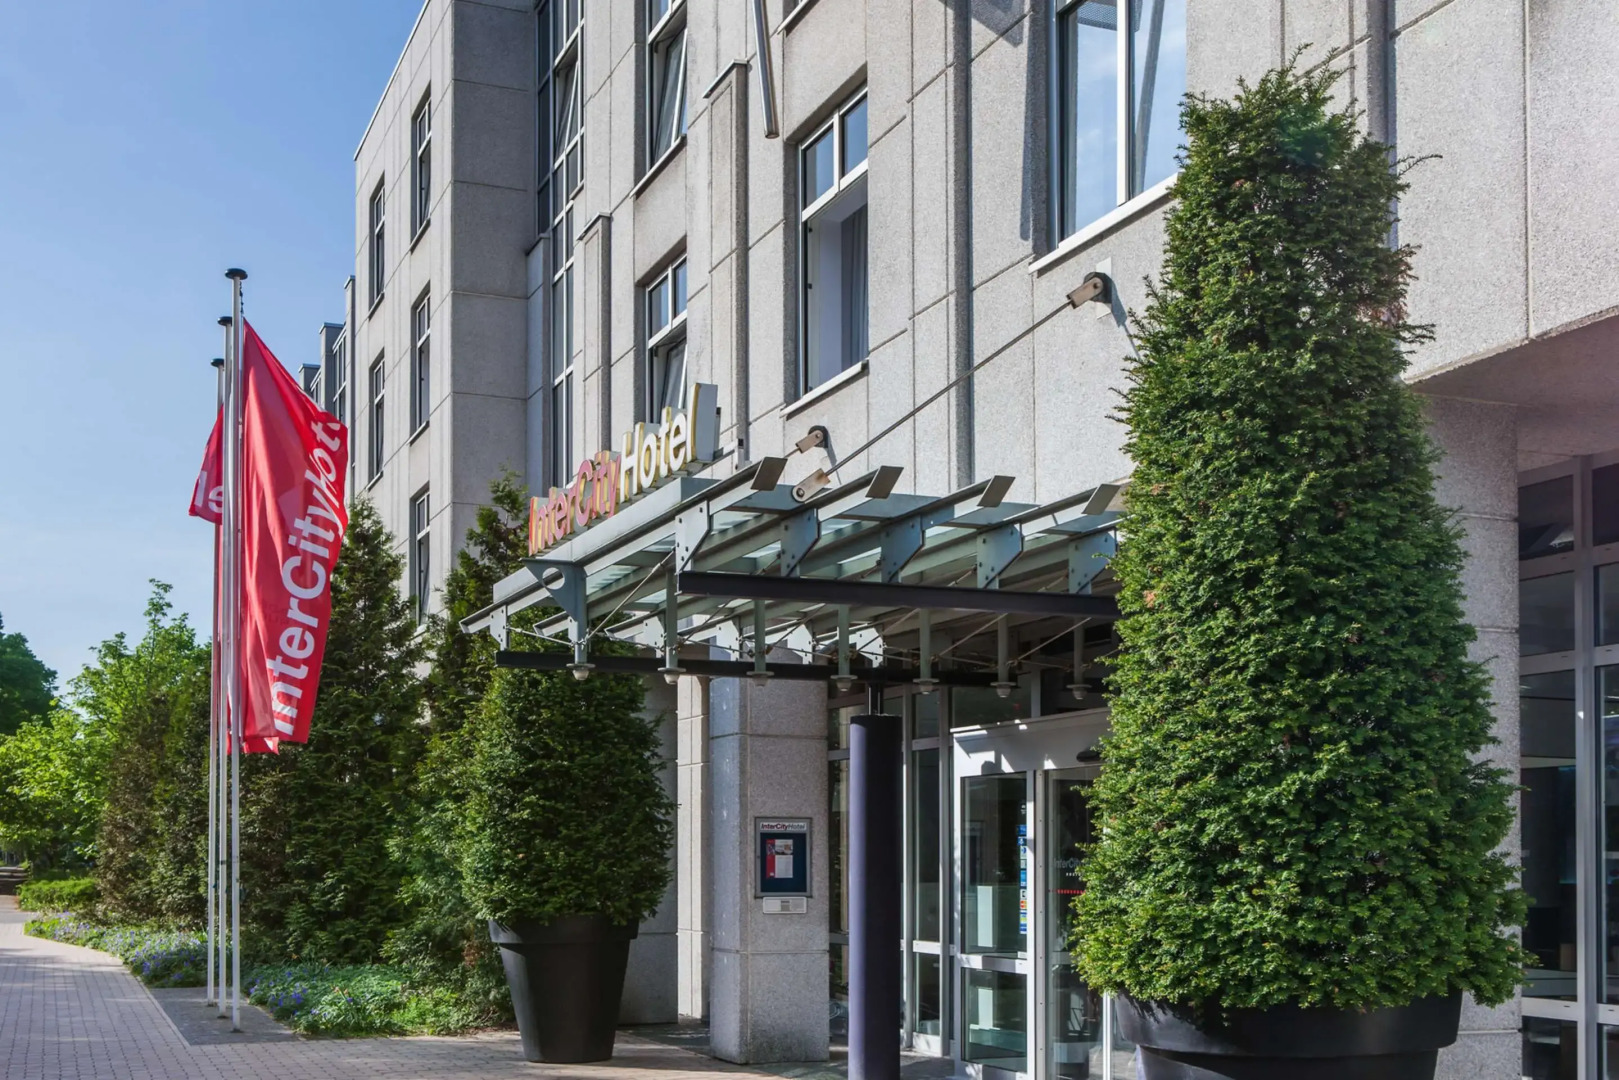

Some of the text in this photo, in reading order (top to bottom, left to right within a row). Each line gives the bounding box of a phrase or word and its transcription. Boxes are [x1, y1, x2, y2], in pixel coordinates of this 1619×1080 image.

[528, 383, 699, 556] InterCityHotel
[266, 420, 343, 737] InterCityHot
[761, 823, 805, 831] InterCityHotel
